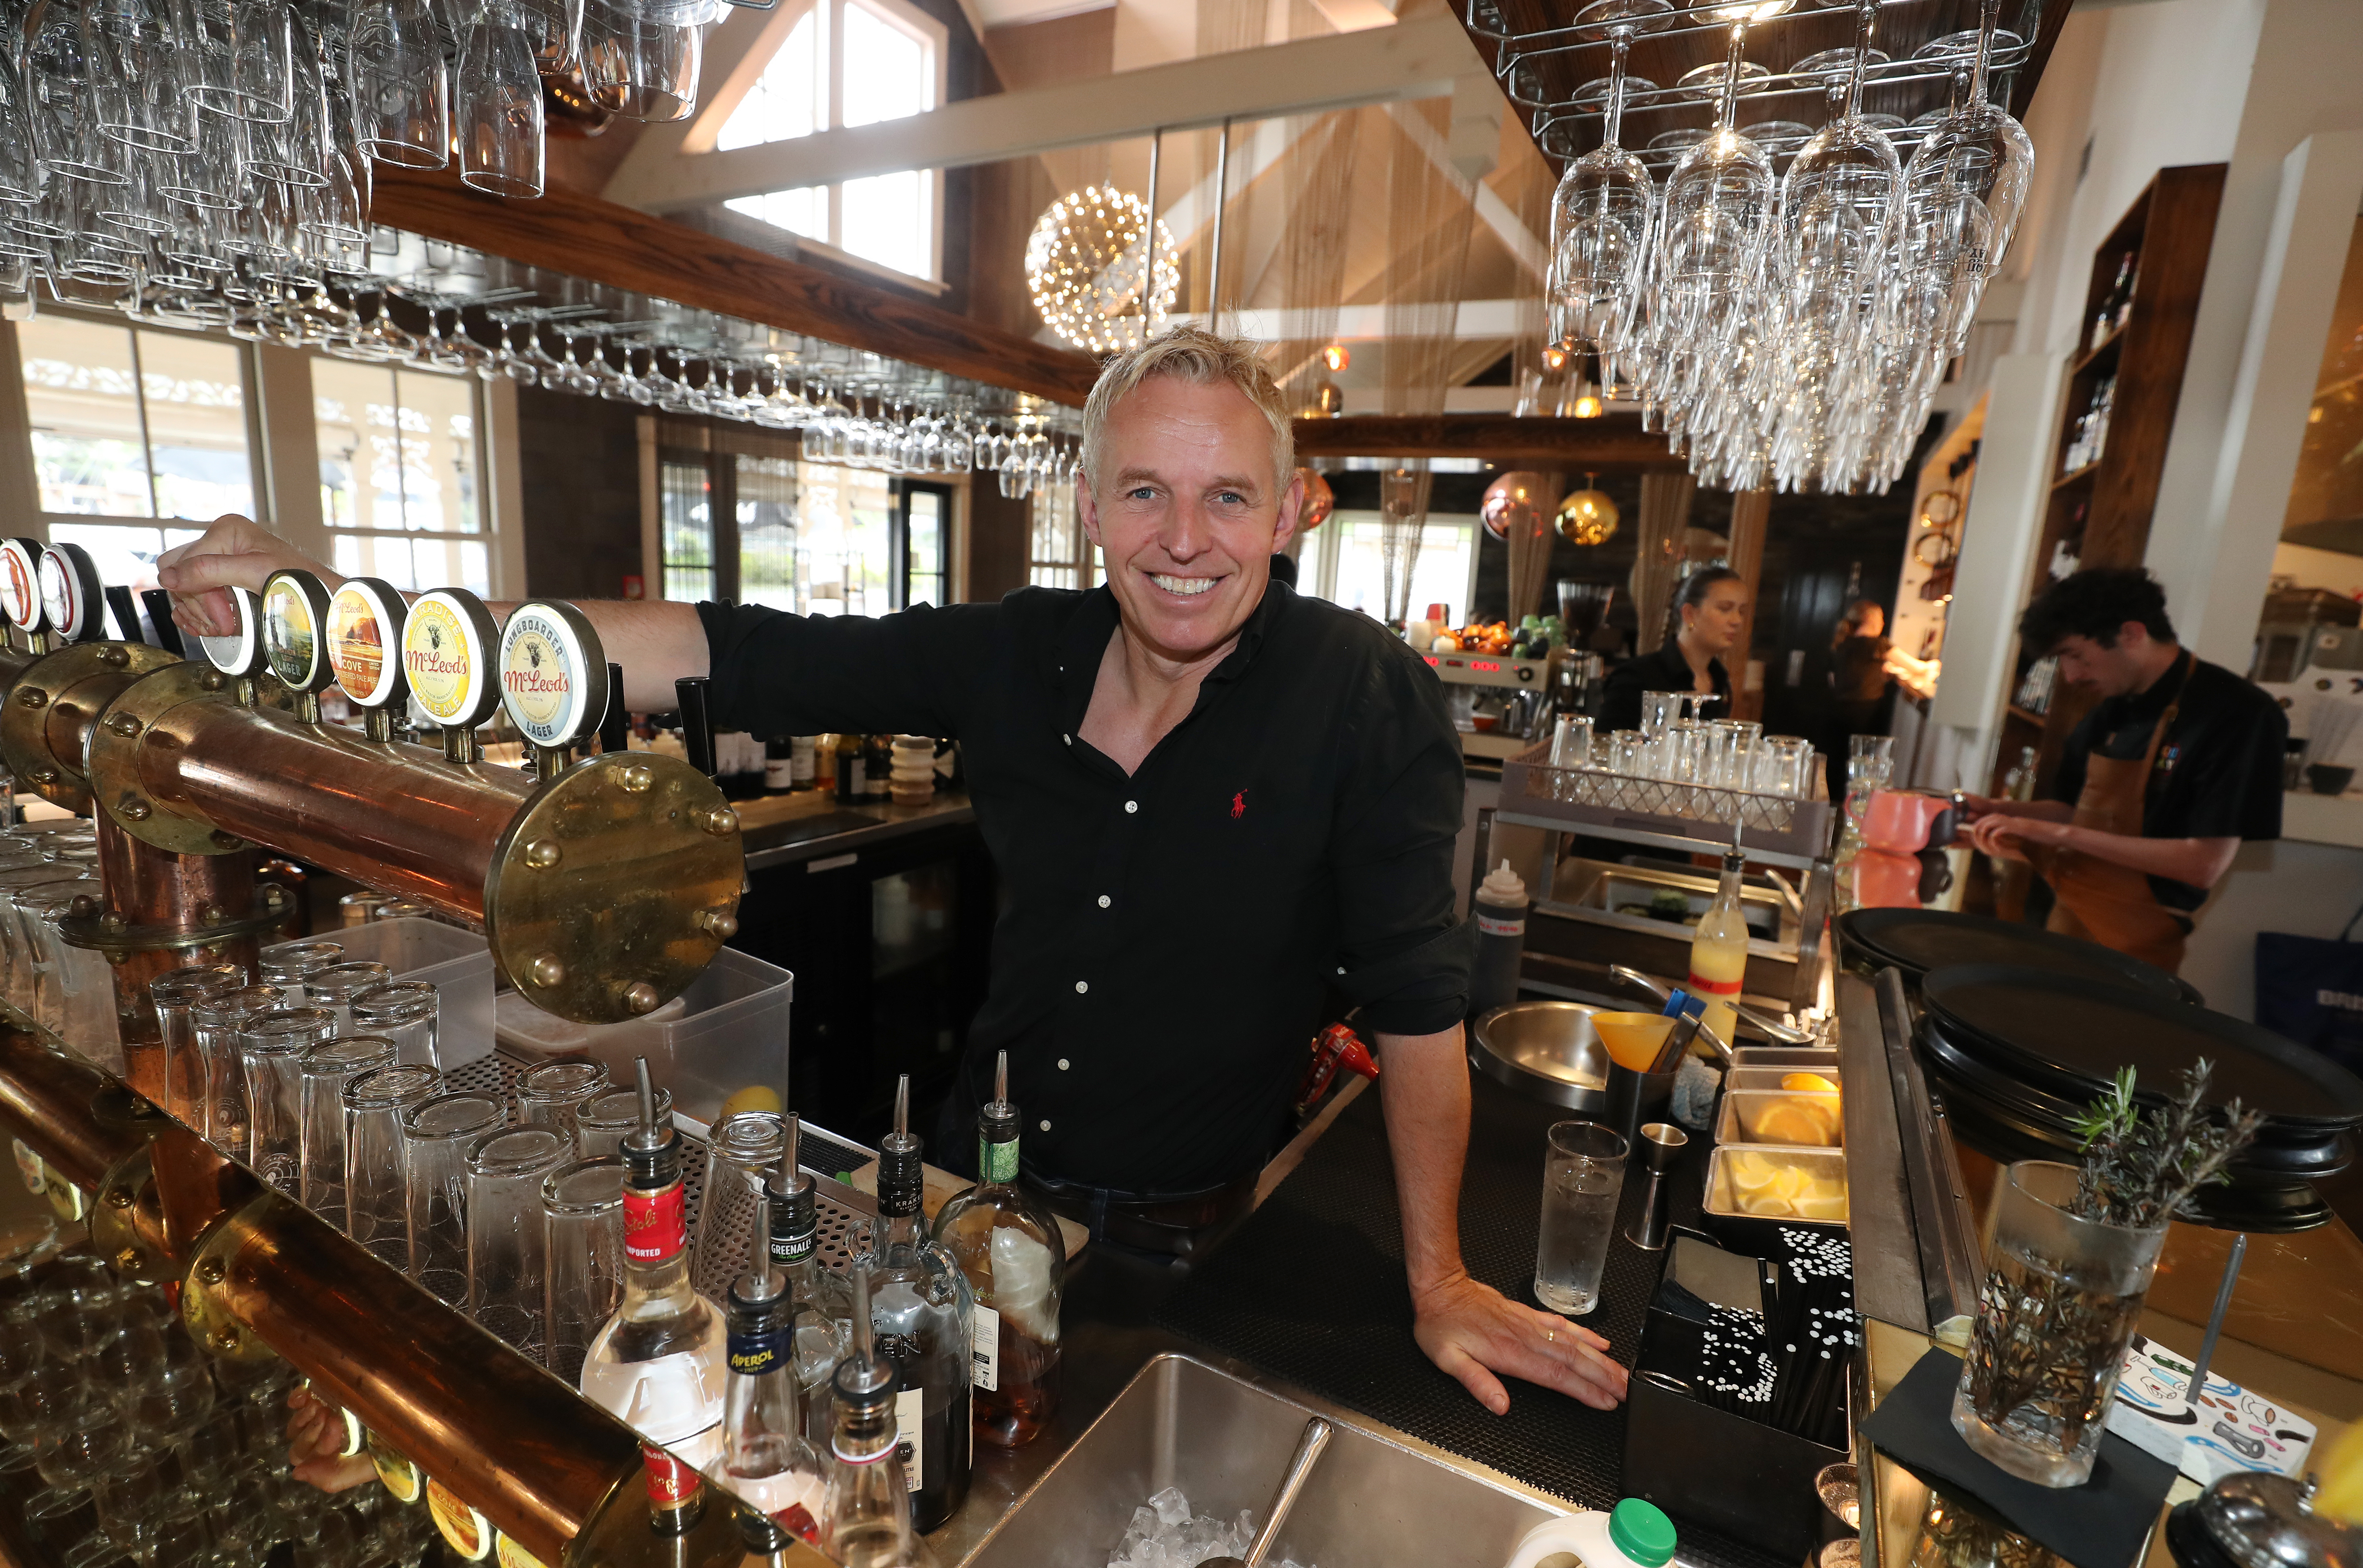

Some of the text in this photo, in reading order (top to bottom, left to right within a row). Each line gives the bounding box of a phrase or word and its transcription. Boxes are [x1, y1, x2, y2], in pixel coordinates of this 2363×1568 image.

[409, 602, 462, 637] PARADISE
[505, 620, 562, 657] LONGBOARDER
[277, 660, 301, 676] LAGER
[342, 659, 362, 672] COVE
[405, 650, 467, 675] McLeod's
[356, 674, 367, 683] PALE
[503, 670, 569, 692] McLeod's
[416, 687, 462, 716] PALE ALE
[526, 721, 553, 737] LAGER
[626, 1245, 661, 1257] IMPORTED
[731, 1349, 775, 1367] APEROL
